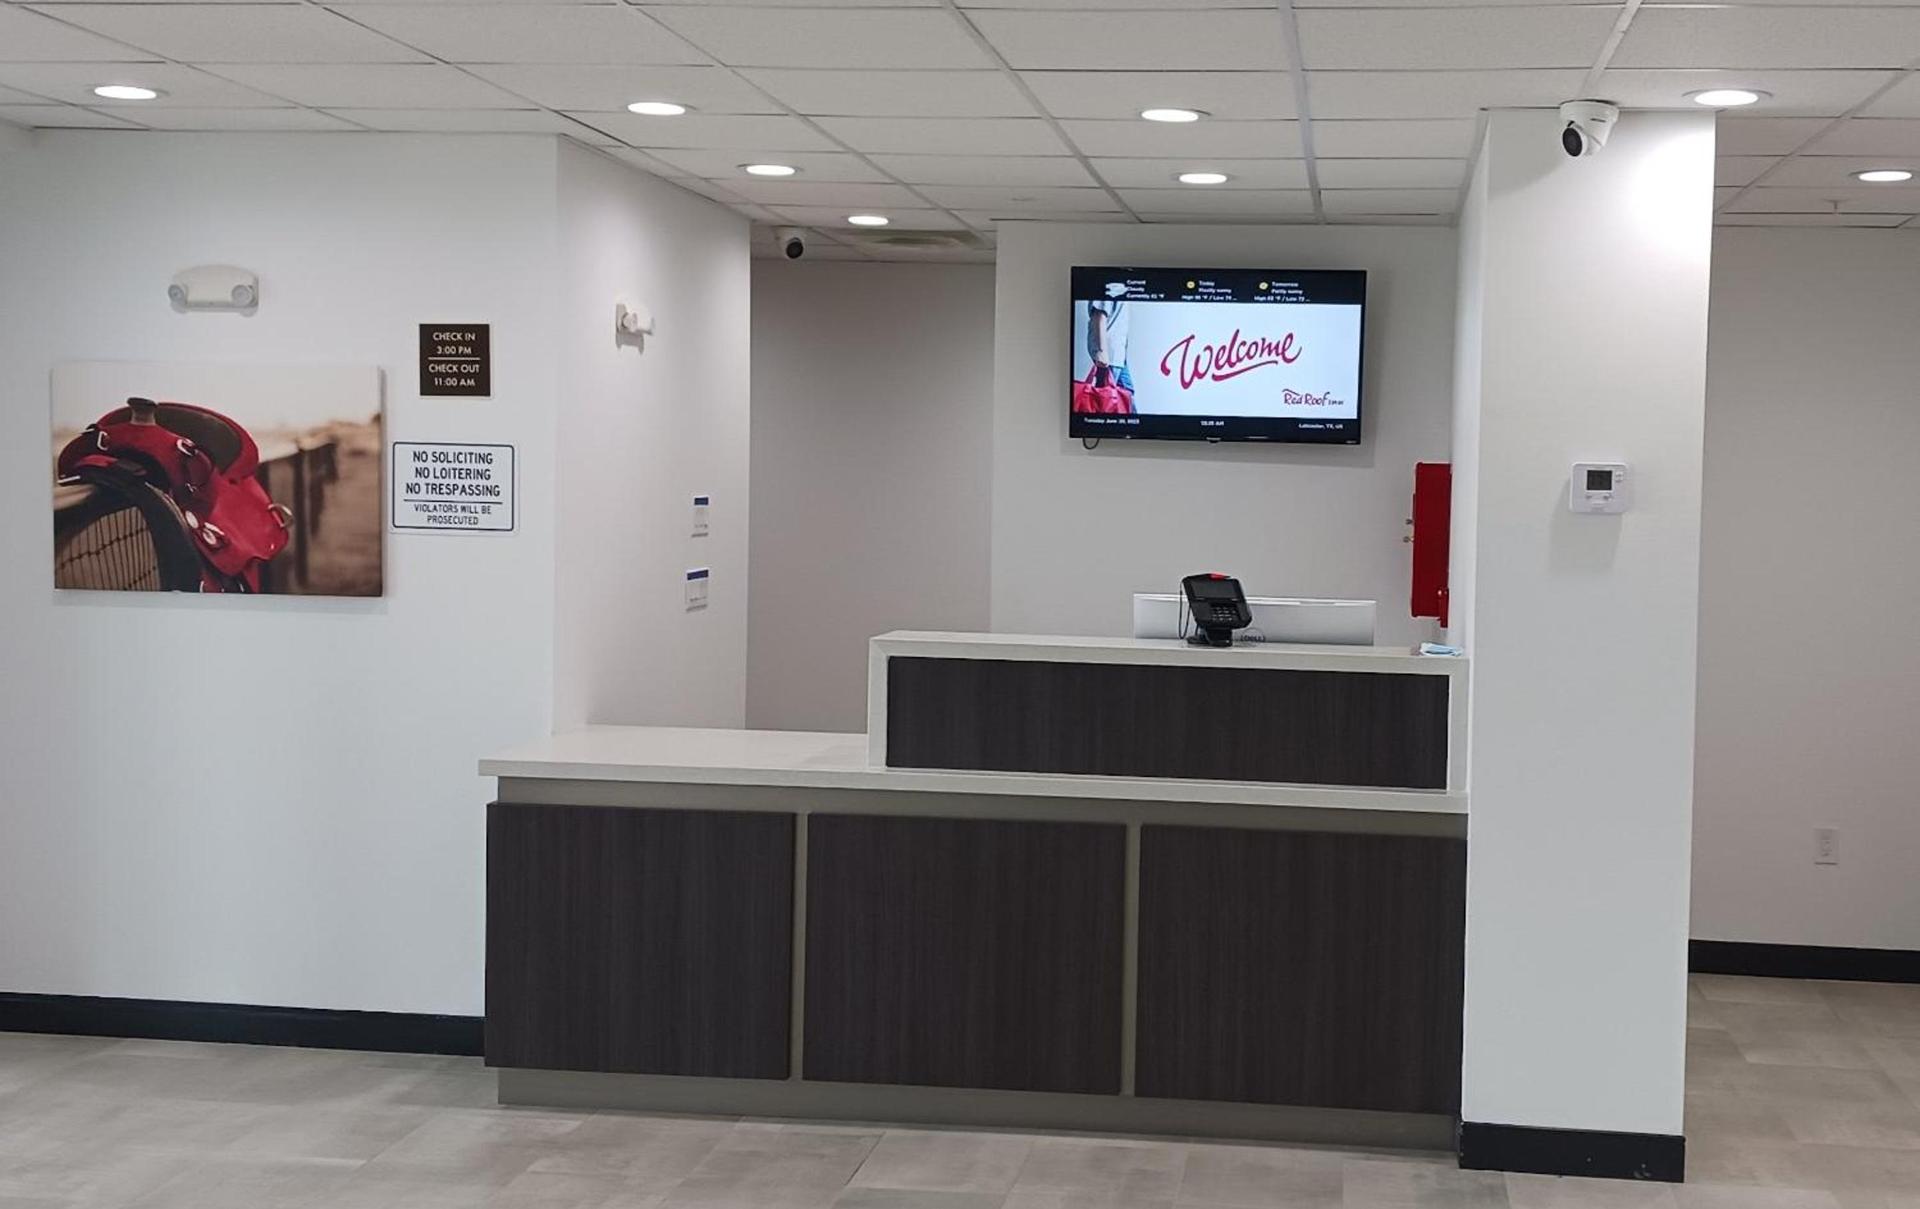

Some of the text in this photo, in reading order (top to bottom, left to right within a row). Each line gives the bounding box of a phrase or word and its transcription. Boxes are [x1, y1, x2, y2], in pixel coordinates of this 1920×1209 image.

[432, 331, 476, 341] CHECK IN
[458, 345, 472, 355] PM
[1160, 328, 1302, 390] Welcome
[428, 363, 480, 373] CHECK OUT
[434, 377, 476, 386] 11:00 AM
[1282, 389, 1303, 405] Red
[1304, 391, 1330, 406] Roof
[412, 450, 493, 465] NO SOLICITING
[415, 466, 491, 481] NO LOITERING
[405, 482, 501, 497] NO TRESPASSING
[414, 503, 492, 515] VIOLATORS WILL BE
[427, 515, 479, 526] PROSECUTED
